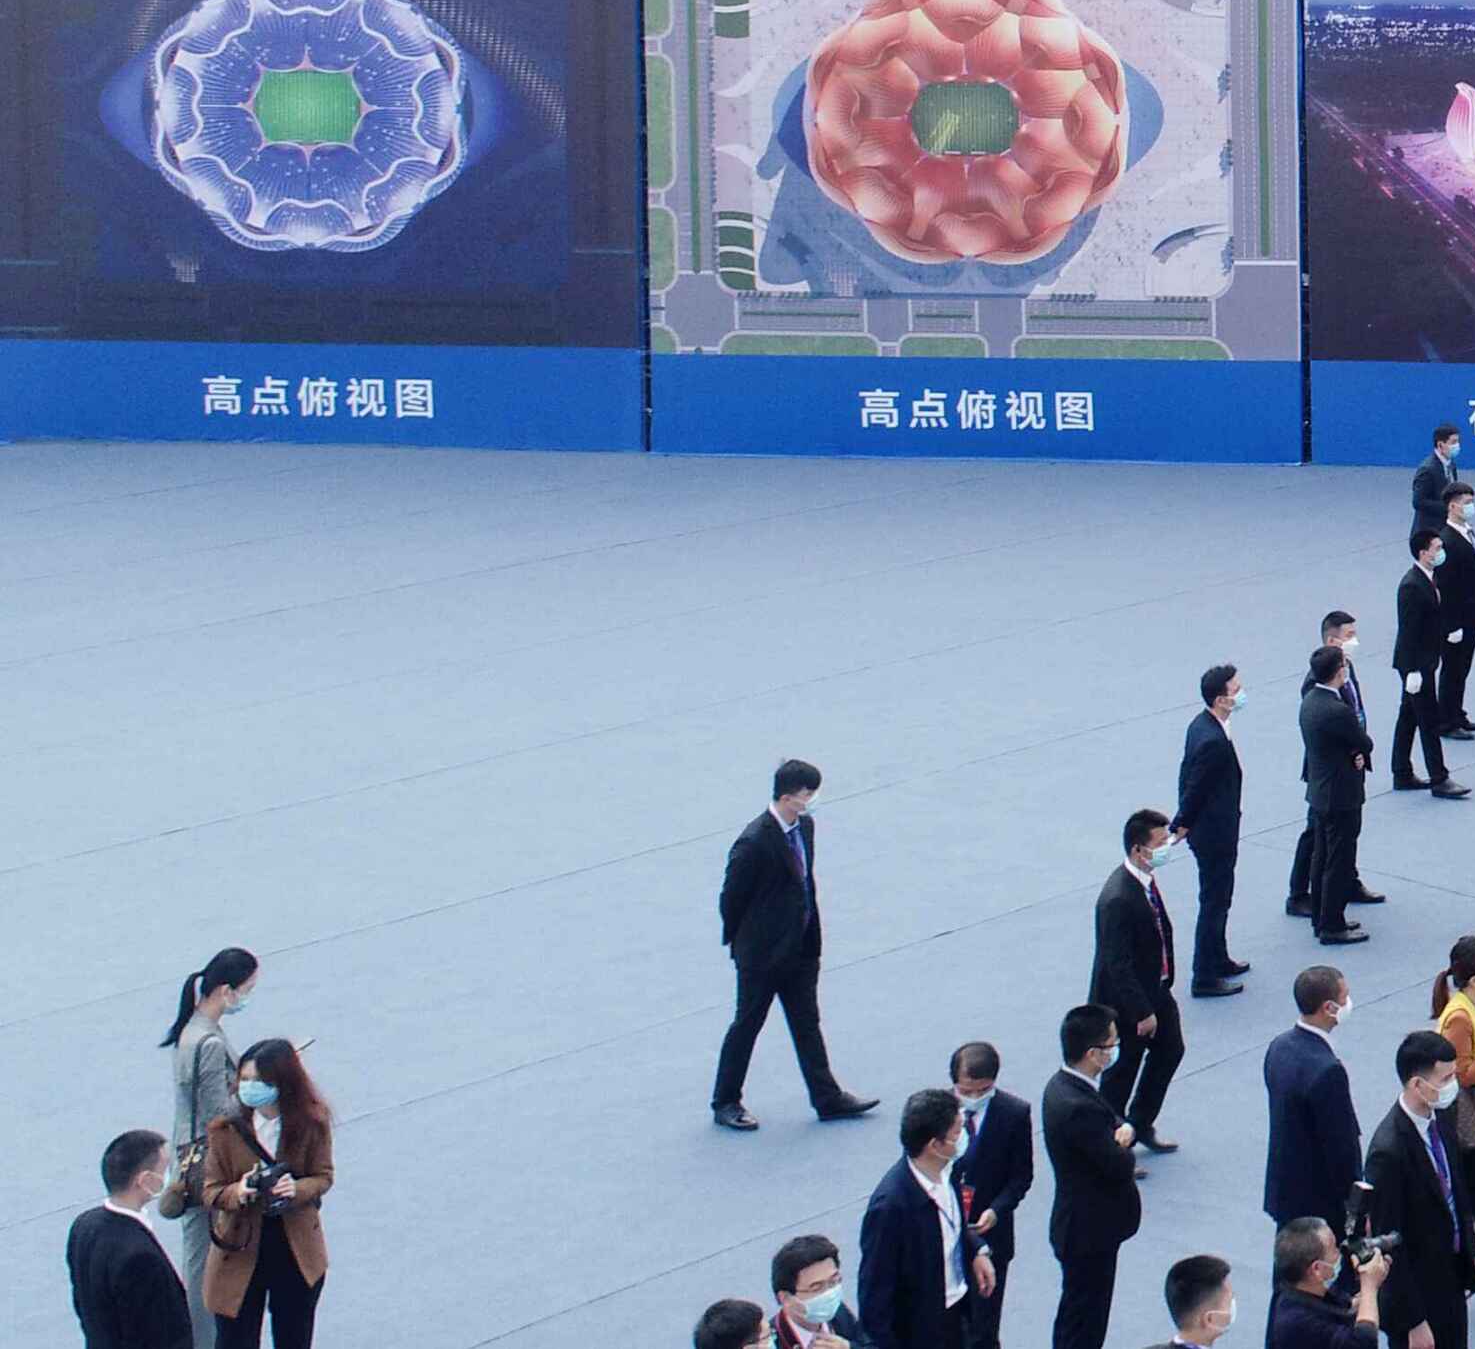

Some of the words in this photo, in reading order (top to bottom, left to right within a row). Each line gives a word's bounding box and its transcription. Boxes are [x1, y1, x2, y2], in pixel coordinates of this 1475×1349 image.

[201, 375, 436, 419] 高点俯视图
[857, 388, 1097, 432] 高点俯视图
